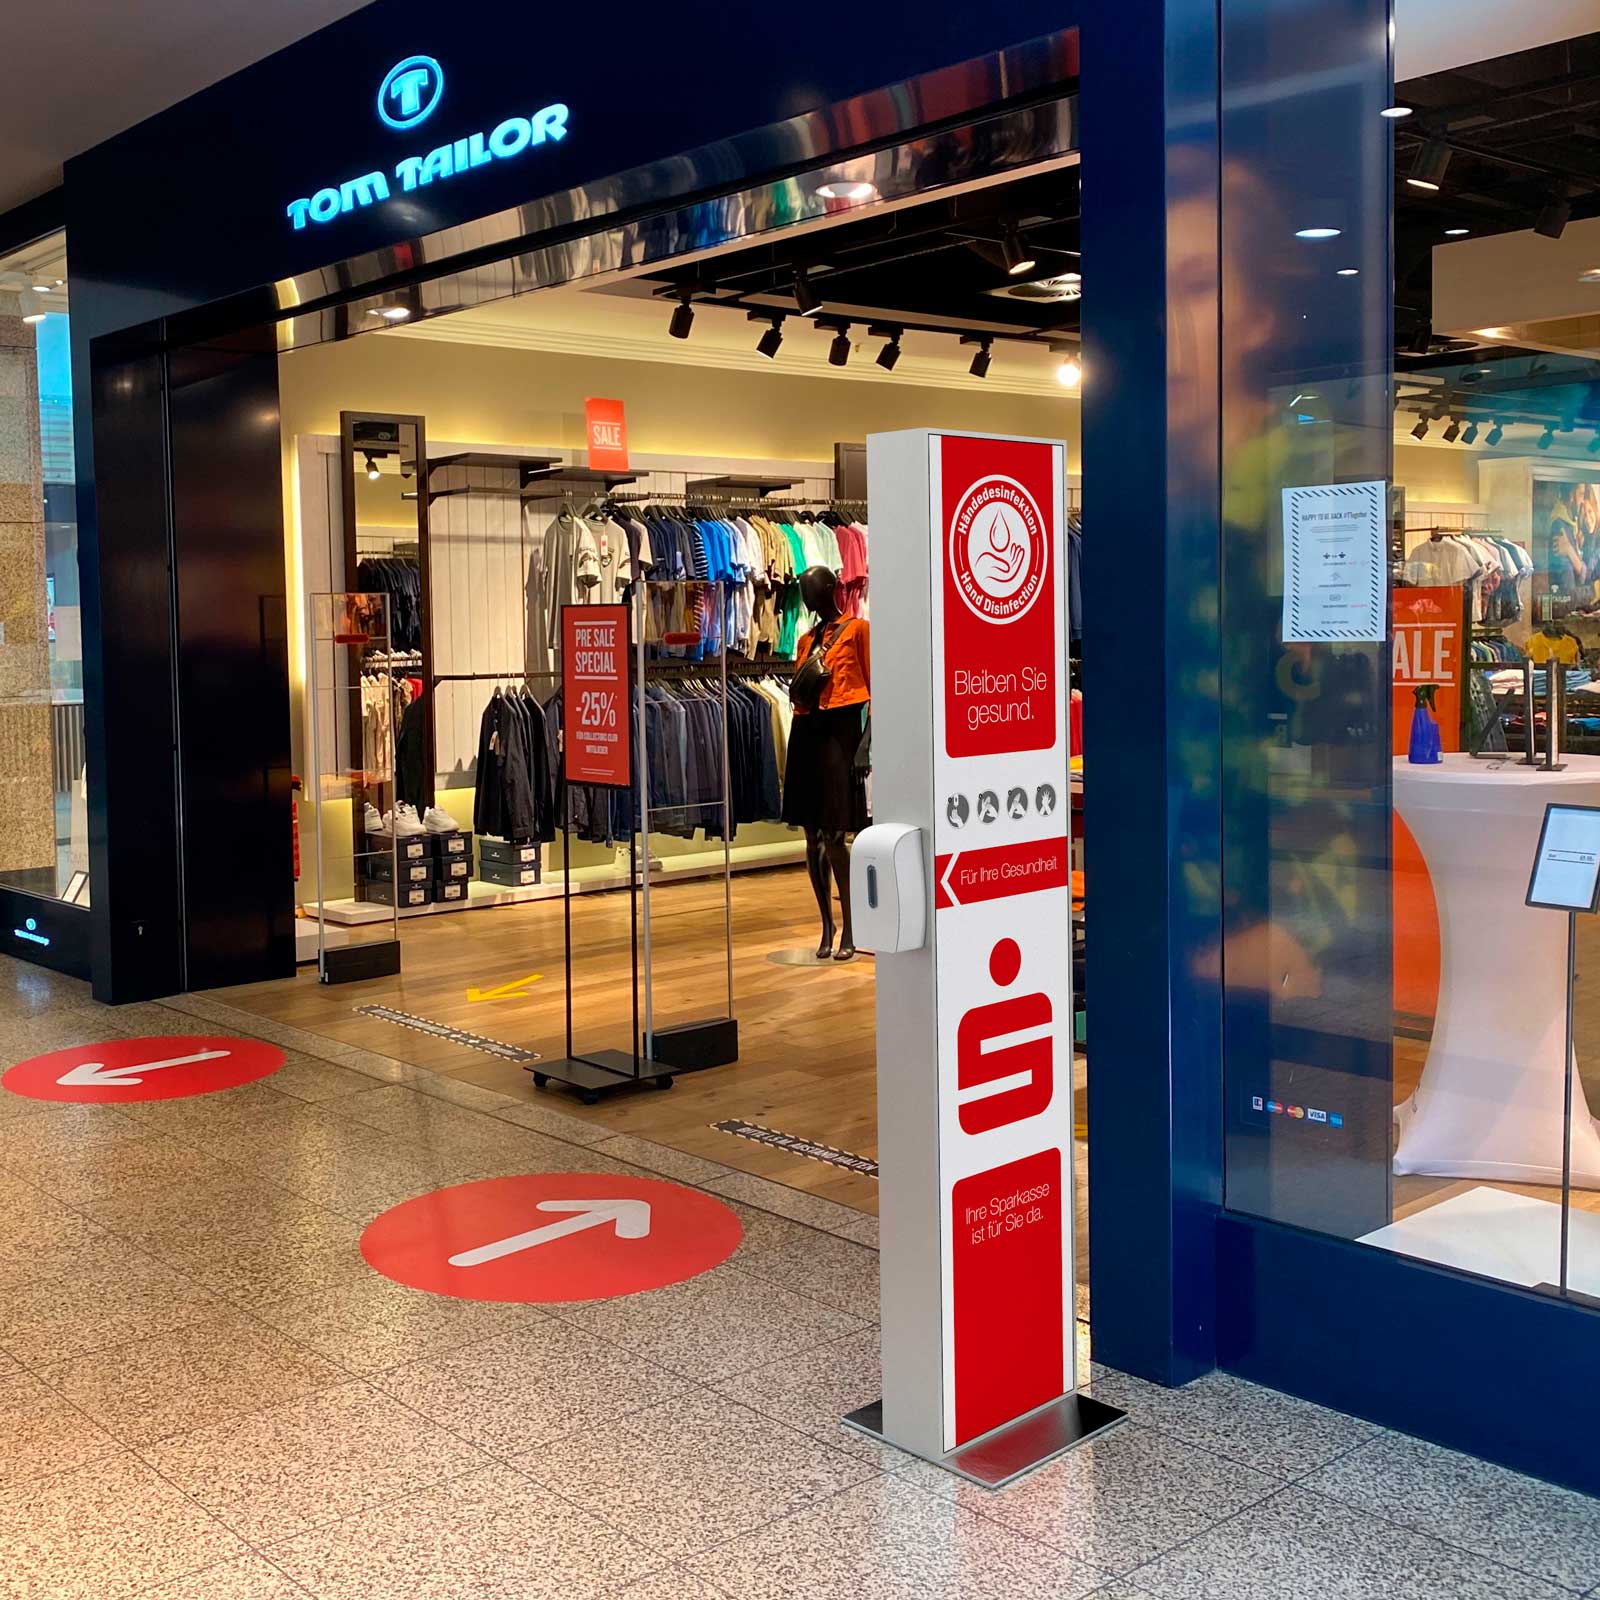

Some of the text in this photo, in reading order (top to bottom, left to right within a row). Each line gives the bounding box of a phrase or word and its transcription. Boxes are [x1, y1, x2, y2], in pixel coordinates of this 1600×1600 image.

[286, 103, 570, 230] TOM TAILOR
[592, 424, 622, 446] SALE
[957, 484, 1038, 536] Händedesinfektion
[960, 571, 1038, 615] Hand Disinfection
[575, 627, 616, 648] PRE SALE
[1392, 630, 1454, 679] ALE
[575, 651, 617, 674] SPECIAL
[954, 666, 1047, 695] Bleiben Sie
[967, 696, 1035, 731] gesund.
[960, 856, 1058, 886] Für Ihre Gesundheit
[1309, 1111, 1326, 1120] VISA
[965, 1183, 1050, 1225] Ihre Sparkasse
[971, 1206, 1044, 1245] ist für Sie da.
